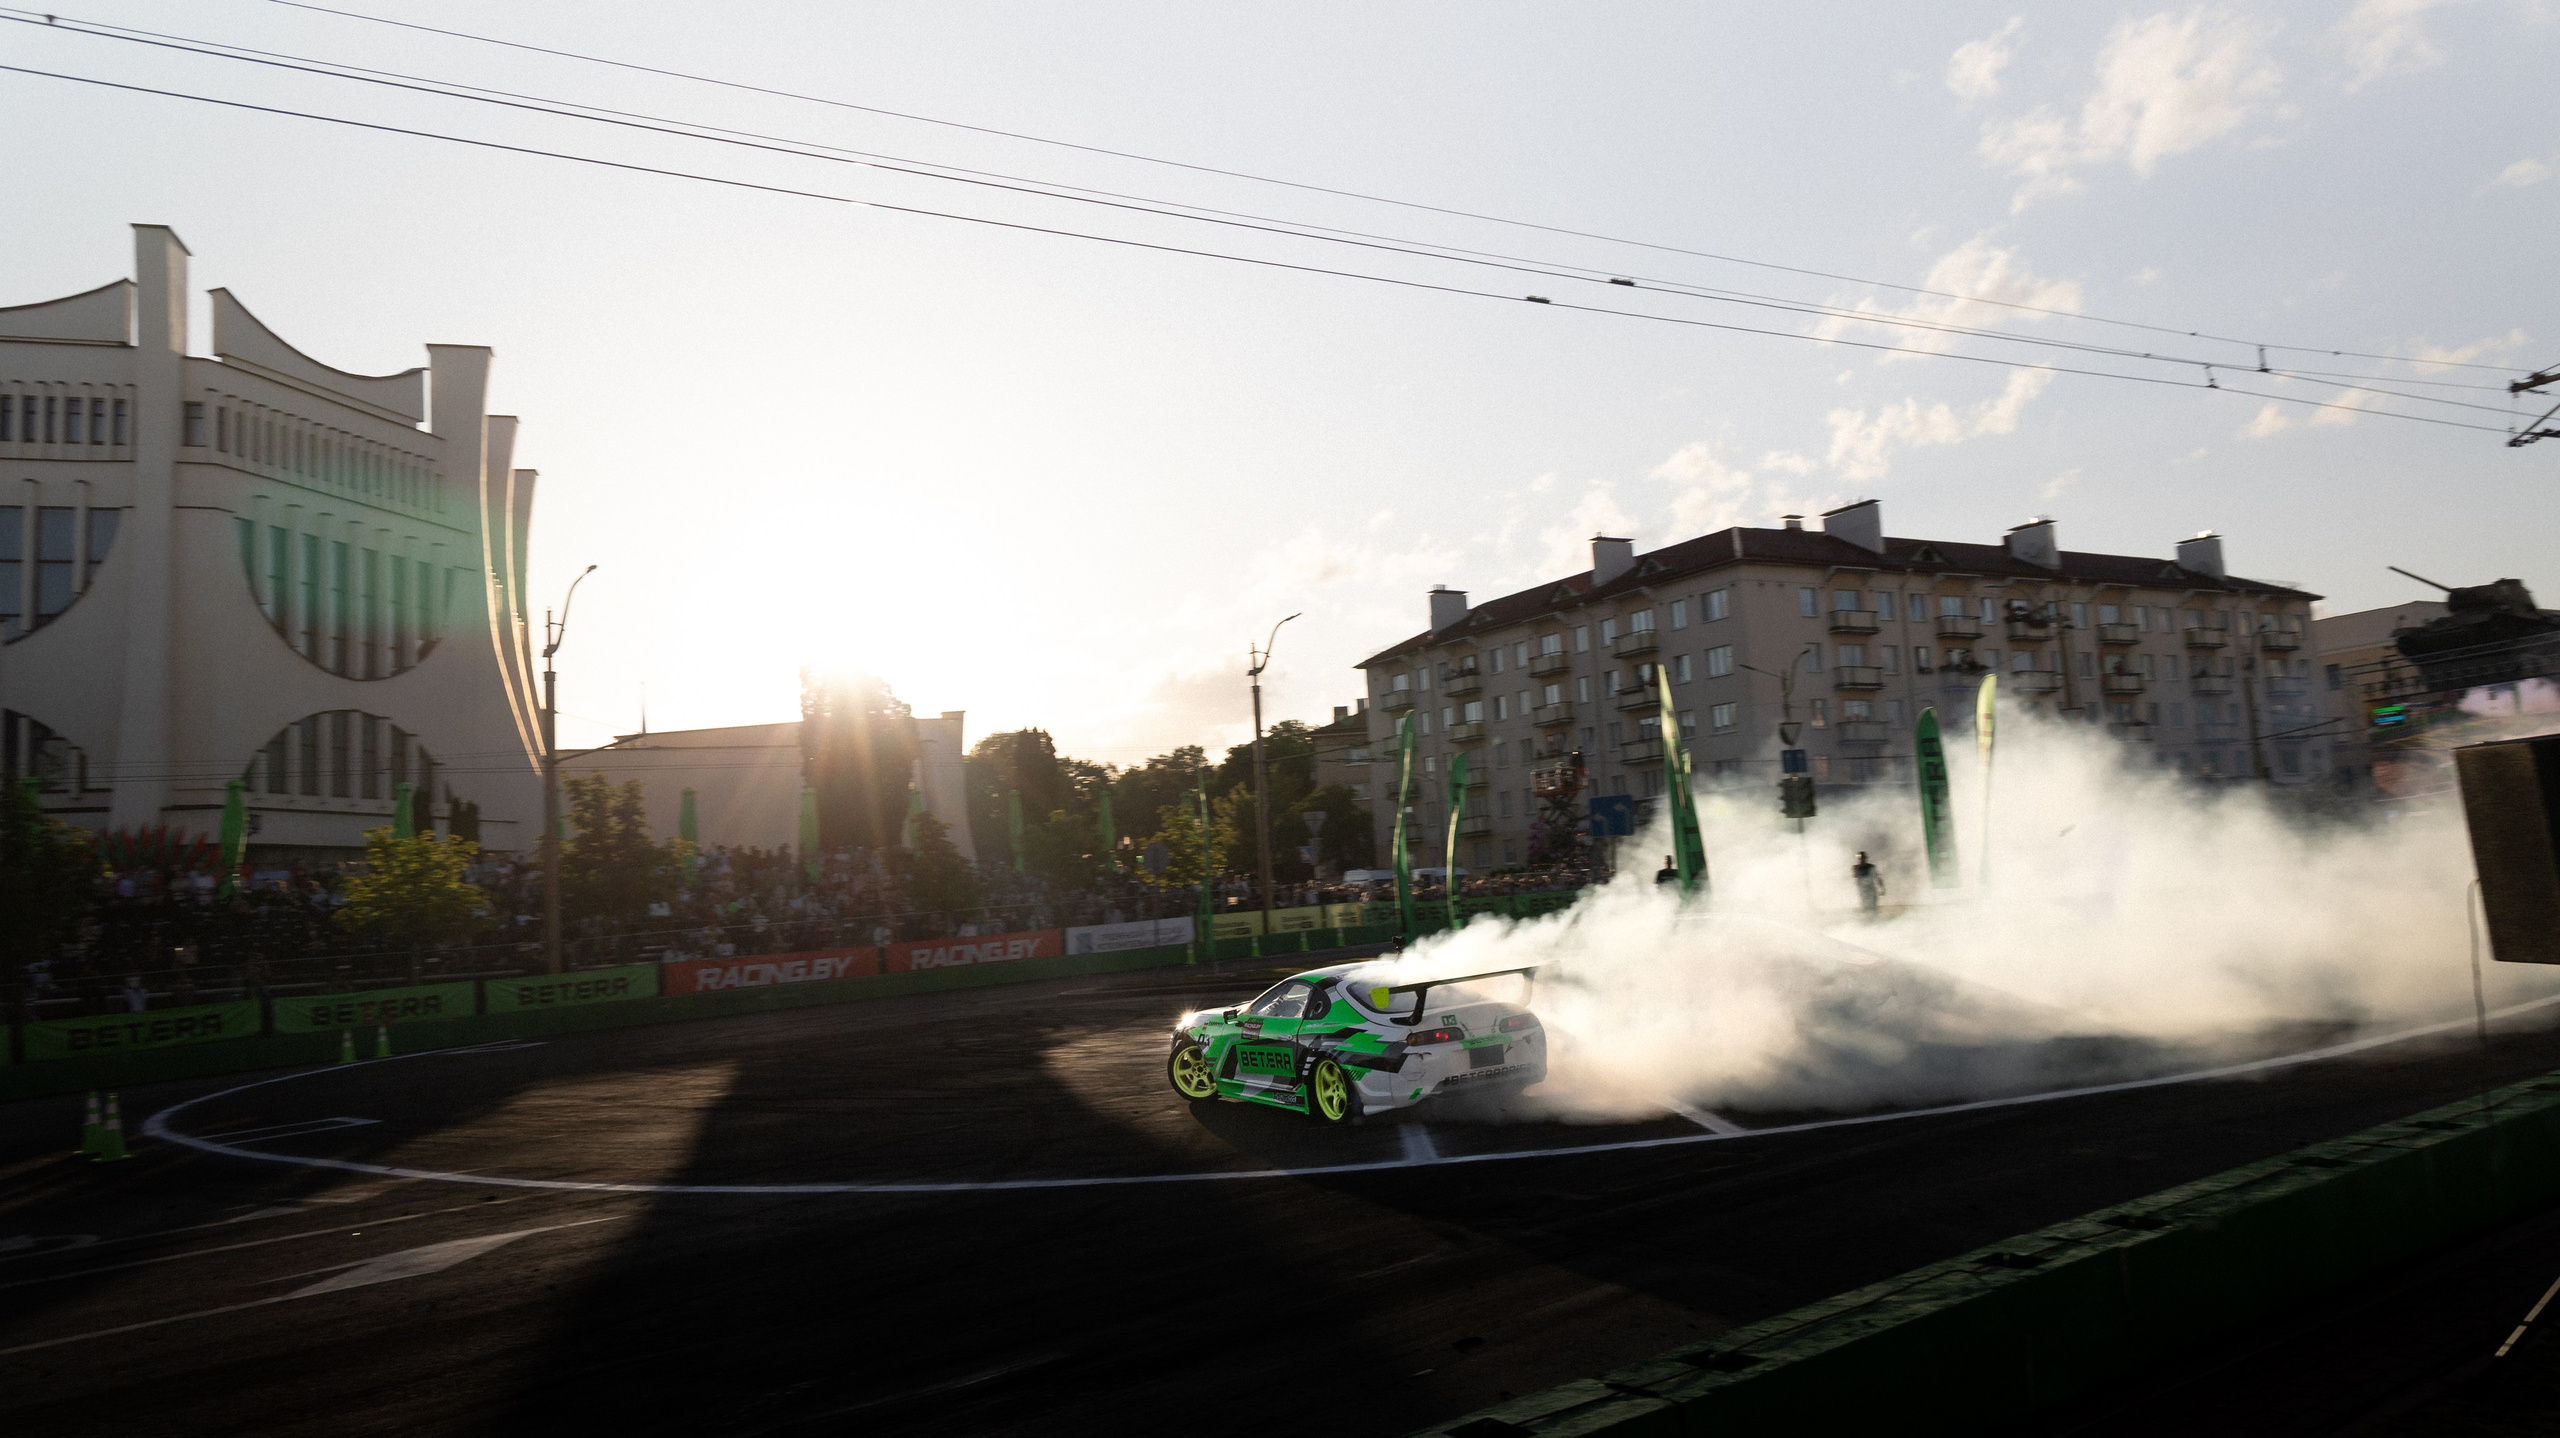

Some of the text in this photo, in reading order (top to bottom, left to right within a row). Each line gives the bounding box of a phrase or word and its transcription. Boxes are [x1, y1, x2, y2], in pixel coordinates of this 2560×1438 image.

[909, 937, 1042, 970] RACING.BY
[694, 956, 854, 992] RACING.BY
[518, 976, 630, 1007] BETERA
[311, 994, 442, 1027] BETERA
[68, 1013, 223, 1051] BETERA
[1240, 1051, 1292, 1070] BETERA
